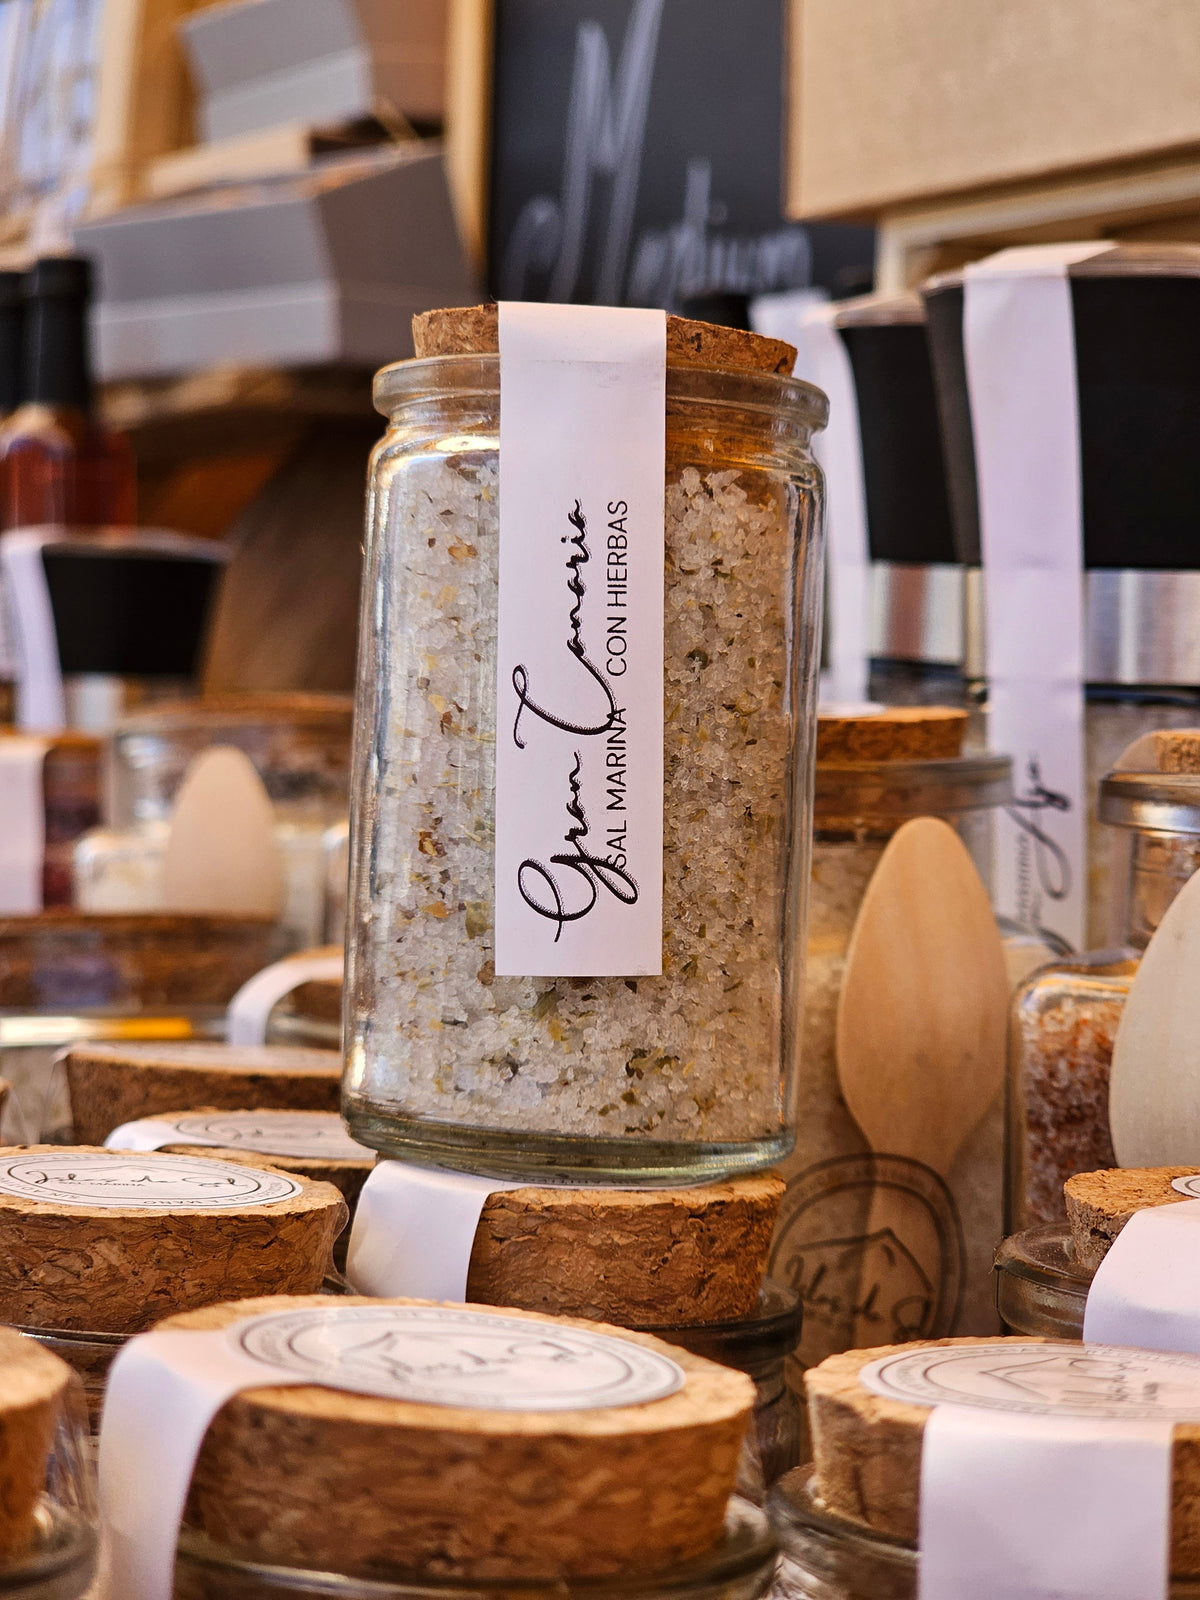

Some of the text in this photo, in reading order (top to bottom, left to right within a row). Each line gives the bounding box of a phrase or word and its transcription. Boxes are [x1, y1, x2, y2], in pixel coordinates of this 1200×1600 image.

[512, 498, 639, 943] Gran Canaria
[605, 500, 628, 869] SAL MARINA CON HIERBAS
